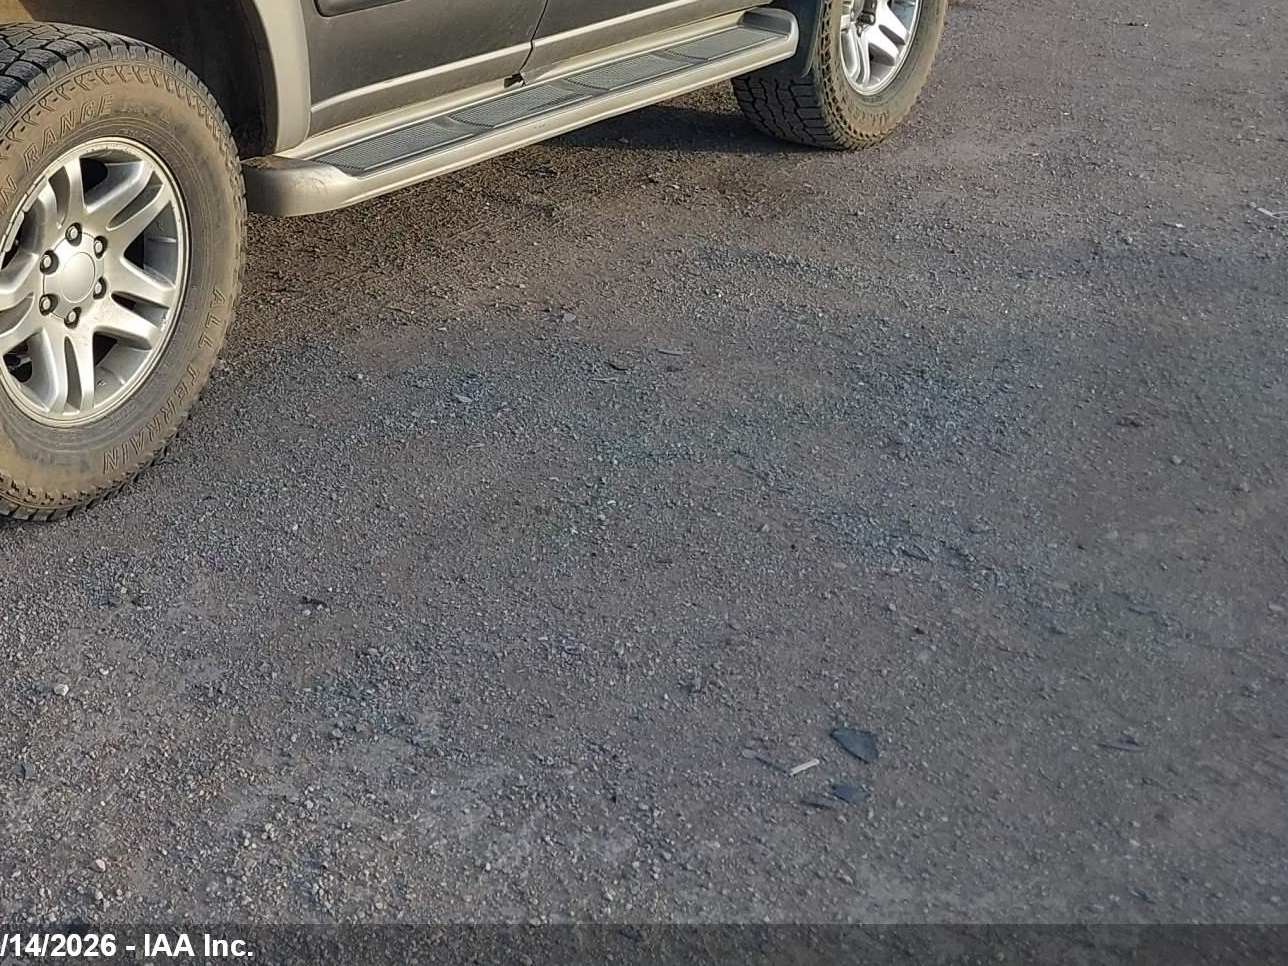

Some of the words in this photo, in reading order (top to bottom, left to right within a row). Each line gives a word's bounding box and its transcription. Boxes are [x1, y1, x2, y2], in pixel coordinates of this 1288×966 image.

[23, 94, 114, 172] RANGE
[198, 286, 227, 350] ALL
[102, 364, 202, 475] TERRAIN
